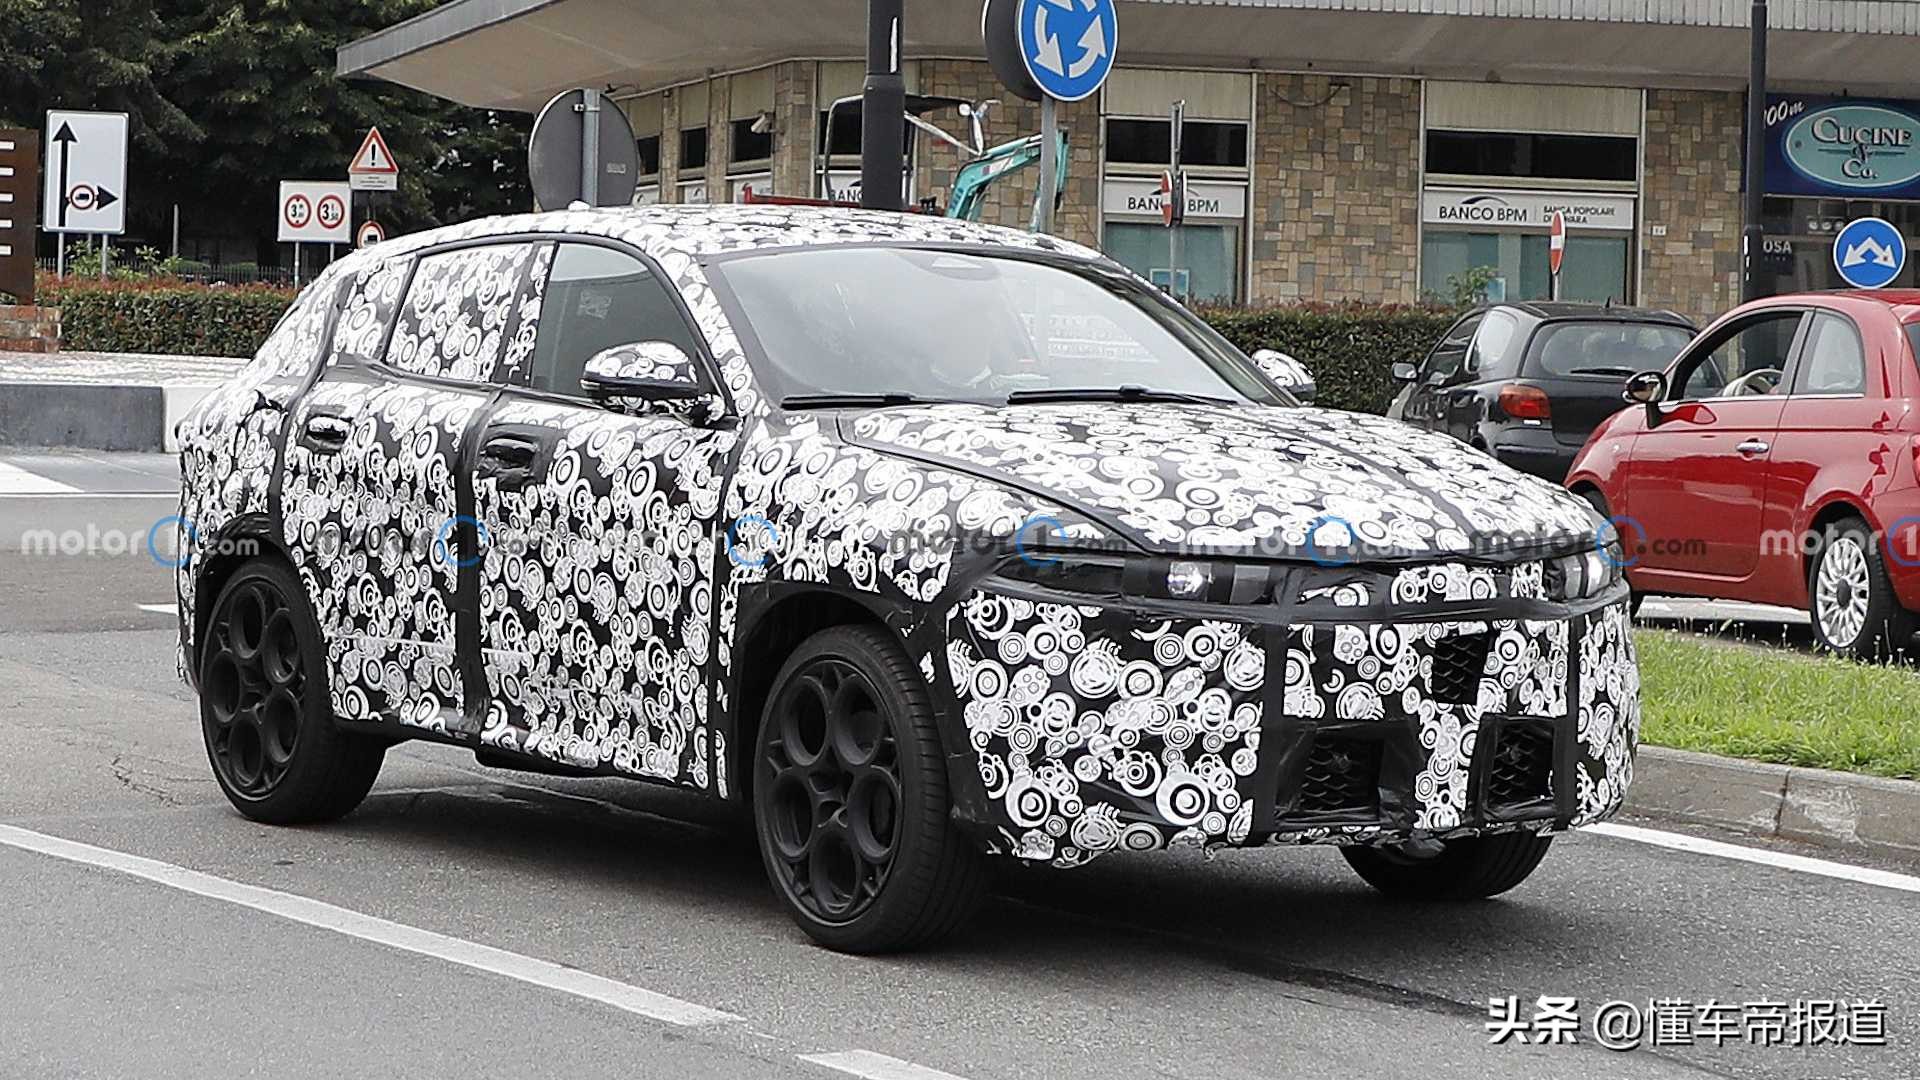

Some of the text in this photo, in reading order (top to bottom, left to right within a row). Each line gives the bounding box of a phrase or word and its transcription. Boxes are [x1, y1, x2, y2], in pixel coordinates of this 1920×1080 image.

[1127, 196, 1220, 213] BAN BPM
[1573, 206, 1615, 217] POPOLARE
[1439, 206, 1527, 222] BANCO BPM
